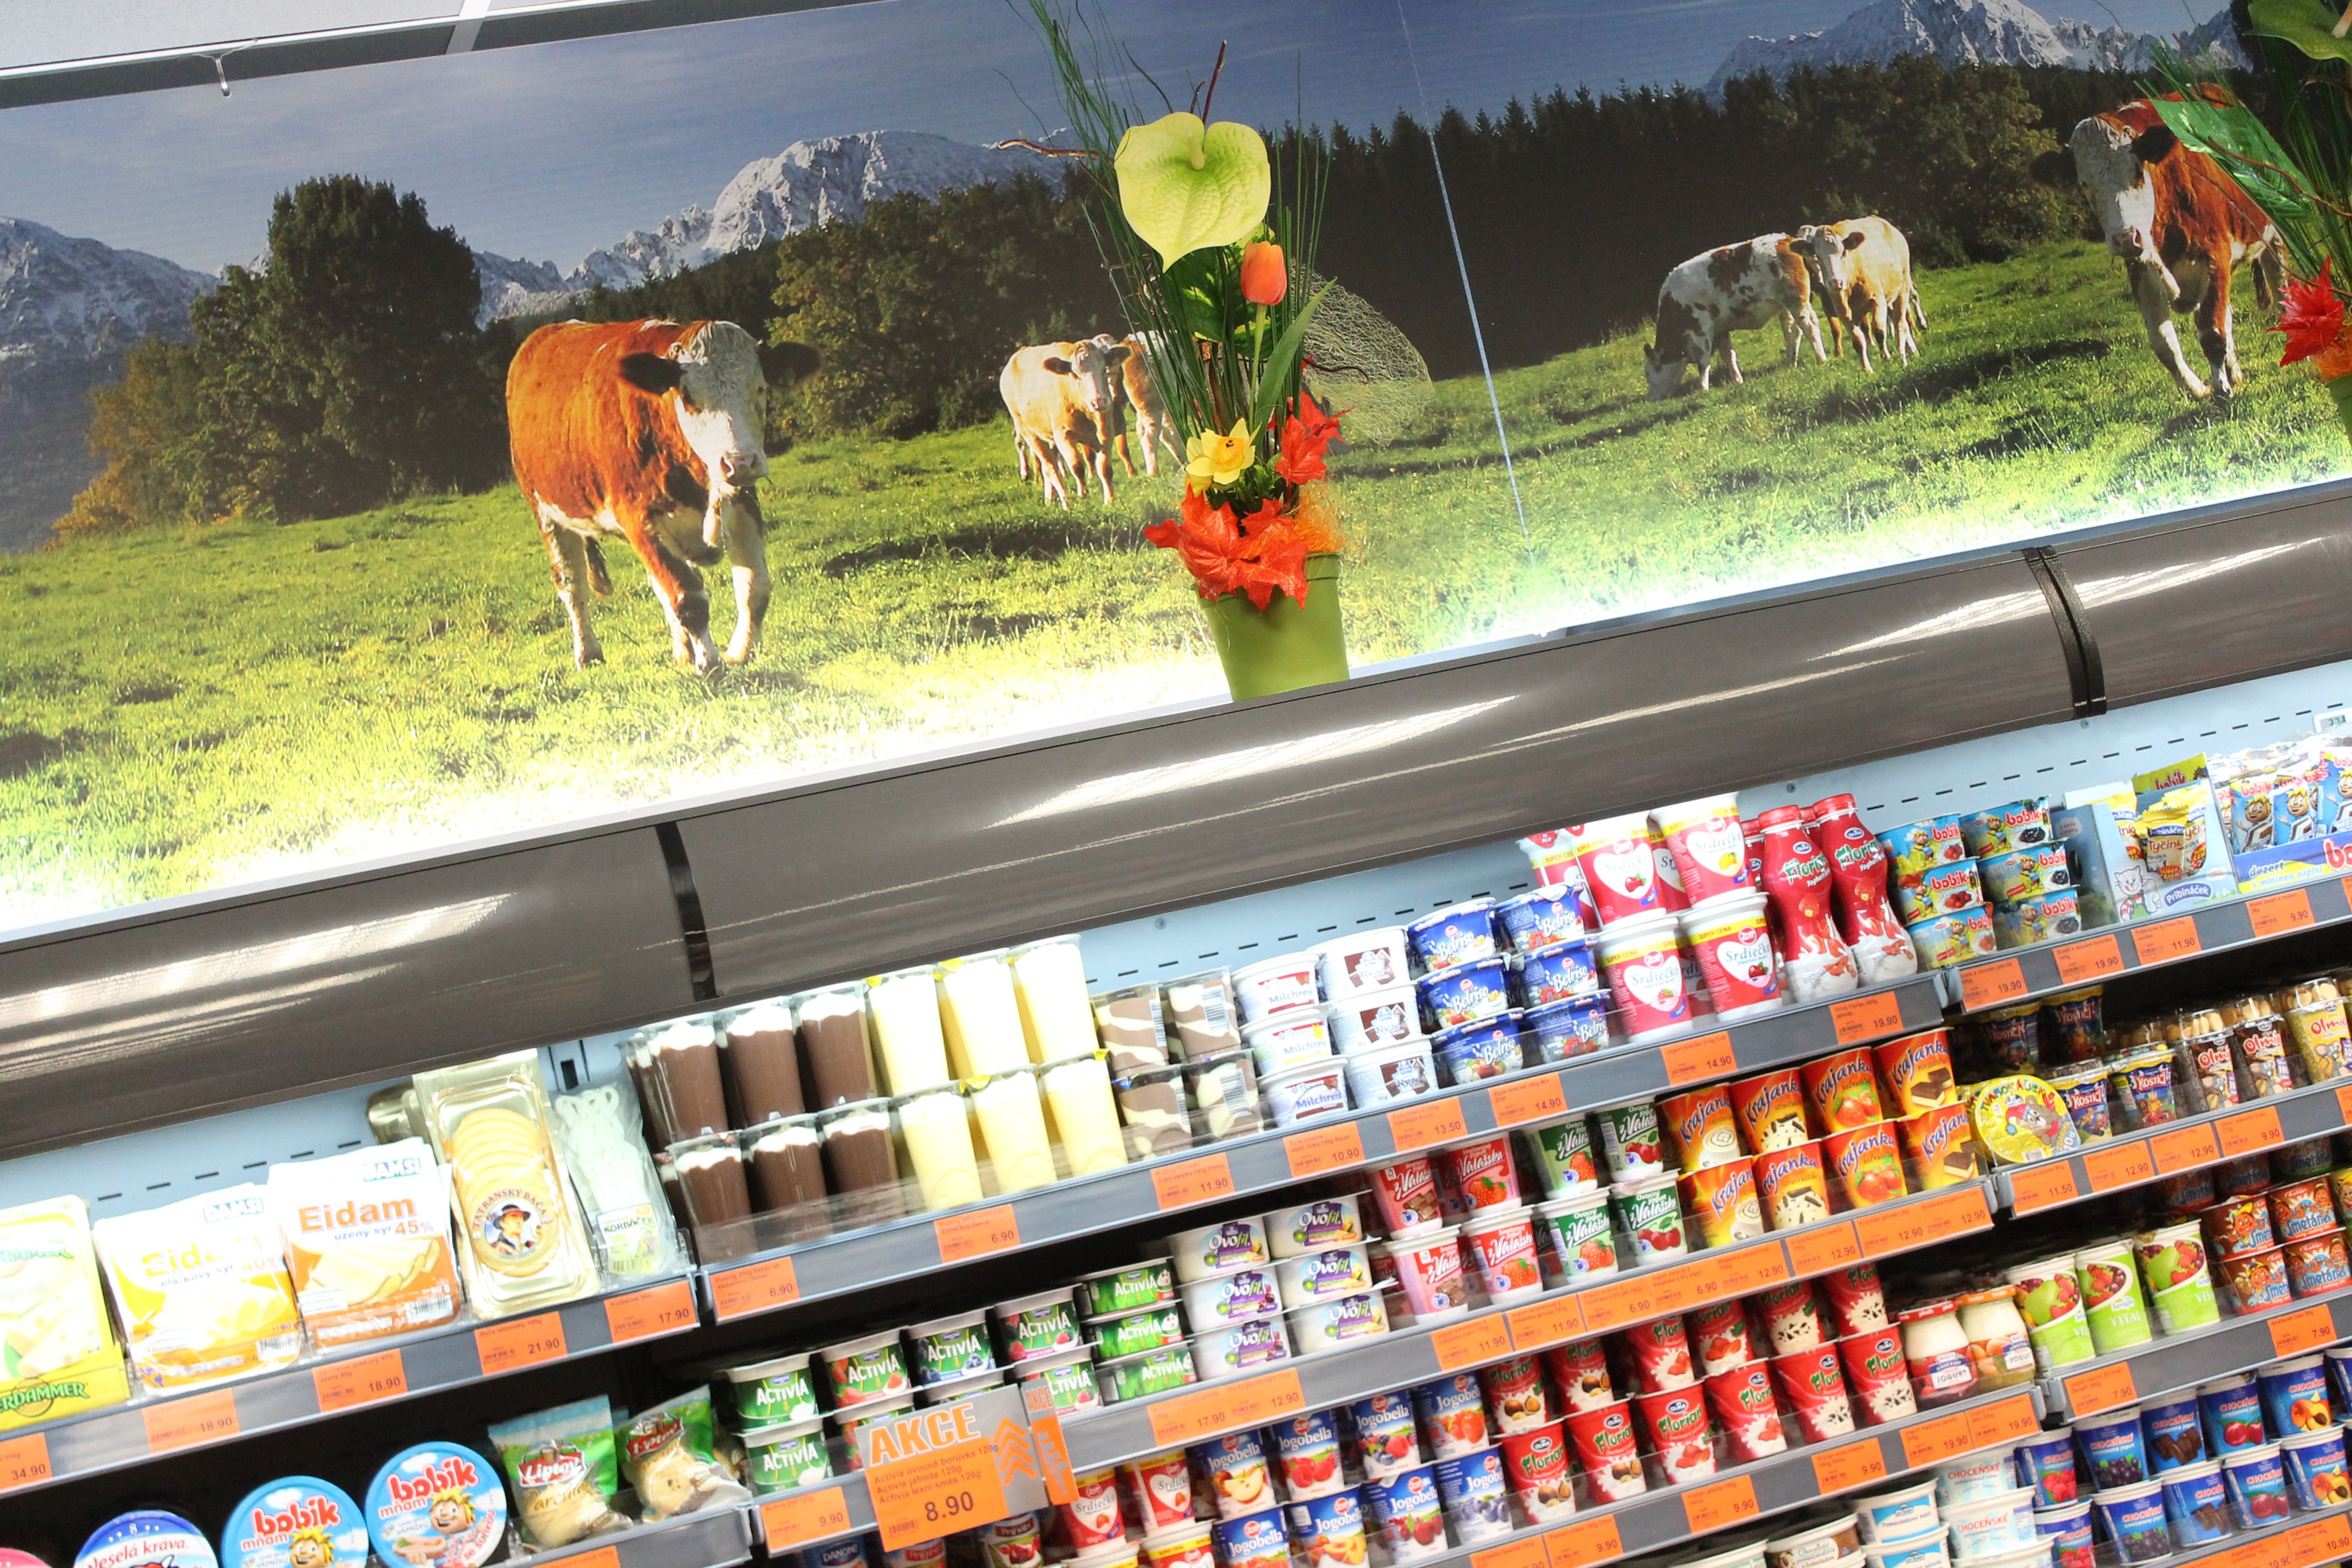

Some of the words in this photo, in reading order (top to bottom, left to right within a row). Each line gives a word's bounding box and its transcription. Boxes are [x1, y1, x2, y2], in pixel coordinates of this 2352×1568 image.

[2240, 780, 2272, 797] bobik
[2004, 808, 2042, 827] bobik
[1932, 823, 1960, 843] bobik
[2039, 850, 2067, 867] bobik
[2249, 861, 2284, 879] dezert
[2259, 873, 2294, 887] mléčnou
[2296, 865, 2323, 880] náplní
[1930, 871, 1967, 891] bobik
[2166, 884, 2209, 903] Pribináček
[2041, 897, 2075, 917] bobik
[2290, 911, 2308, 921] 9.90
[1544, 910, 1576, 938] Belriso
[1699, 931, 1716, 940] SUPER
[1717, 927, 1732, 935] CENA
[1439, 931, 1475, 961] Belriso
[1726, 942, 1770, 962] Srdiečko
[2172, 938, 2195, 951] 11.90
[2095, 957, 2118, 969] 19.90
[1554, 965, 1588, 993] Belriso
[1998, 981, 2022, 994] 19.90
[1454, 986, 1489, 1015] Belriso
[1873, 1015, 1897, 1028] 19.90
[1485, 1037, 1516, 1066] Belriso
[1706, 1056, 1732, 1069] 14.90
[1891, 1039, 1947, 1095] Krajanka
[1815, 1057, 1872, 1114] Krajanka
[2136, 1070, 2169, 1091] KOSTÍCI
[1297, 1090, 1343, 1110] Milchreis
[1535, 1098, 1561, 1111] 14.90
[2073, 1090, 2102, 1107] KOSTÍCI
[1435, 1121, 1461, 1135] 13.50
[1679, 1093, 1730, 1152] Krajank
[1921, 1106, 1968, 1165] Krajank
[2262, 1129, 2280, 1140] 9.90
[1332, 1149, 1359, 1162] 10.90
[1837, 1130, 1895, 1185] Krajanka
[2191, 1145, 2214, 1158] 12.90
[1763, 1152, 1816, 1195] rajanka
[2126, 1164, 2149, 1176] 12.90
[1200, 1178, 1228, 1192] 11.90
[2049, 1184, 2073, 1196] 11.50
[1636, 1192, 1660, 1202] Ovocný
[298, 1197, 417, 1234] Eidam
[1962, 1210, 1986, 1223] 12.90
[2286, 1211, 2333, 1236] Smetánek
[395, 1220, 435, 1235] 45%
[991, 1231, 1015, 1243] 6.90
[1899, 1228, 1923, 1241] 12.90
[1831, 1246, 1856, 1259] 12.90
[1759, 1265, 1783, 1279] 12.90
[2301, 1268, 2347, 1290] Smetánek
[769, 1283, 793, 1298] 6.90
[1115, 1274, 1158, 1297] ACTIVIA
[1697, 1282, 1716, 1295] 6.90
[658, 1308, 689, 1324] 17.90
[1629, 1301, 1650, 1313] 6.90
[1018, 1311, 1071, 1339] ACTIVIA
[1118, 1319, 1162, 1342] ACTIVIA
[1552, 1319, 1578, 1332] 11.90
[2312, 1326, 2330, 1338] 7.90
[528, 1338, 559, 1354] 21.90
[927, 1334, 981, 1362] ACTIVIA
[1479, 1336, 1505, 1350] 11.90
[848, 1354, 901, 1384] ACTIVIA
[1142, 1358, 1184, 1381] ACTIVIA
[1937, 1369, 1967, 1383] JOGURT
[369, 1377, 401, 1393] 18.90
[756, 1378, 810, 1406] ACTIVIA
[1048, 1372, 1092, 1395] CTIVIA
[2113, 1387, 2132, 1399] 7.90
[1026, 1387, 1052, 1413] AKCE
[1271, 1392, 1298, 1406] 12.90
[1437, 1384, 1480, 1410] Jogobell
[201, 1417, 233, 1433] 18.90
[1197, 1412, 1225, 1427] 17.90
[1356, 1405, 1409, 1429] Jogobella
[1658, 1403, 1703, 1440] Florian
[2009, 1417, 2033, 1430] 19.90
[870, 1403, 981, 1462] AKCE
[1279, 1427, 1332, 1450] Jogobella
[1943, 1436, 1968, 1450] 19.90
[763, 1443, 818, 1472] ACTIVIA
[874, 1471, 904, 1485] Activia
[906, 1460, 938, 1475] ovocná
[941, 1451, 975, 1466] borůvka
[978, 1444, 998, 1456] 120g
[1207, 1442, 1261, 1471] Jogobella
[1522, 1443, 1563, 1477] Florian
[12, 1464, 46, 1481] 34.90
[386, 1456, 479, 1501] bobik
[1862, 1462, 1882, 1476] 9.90
[1947, 1463, 2000, 1479] CHOCEŇSKÉ
[877, 1480, 907, 1494] Activia
[909, 1472, 939, 1487] jahoda
[941, 1465, 963, 1478] 120g
[880, 1490, 910, 1505] Activia
[961, 1470, 982, 1483] 120g
[379, 1497, 427, 1519] mňam
[925, 1491, 974, 1522] 8.90
[1389, 1485, 1439, 1513] Jogobell
[1733, 1499, 1754, 1513] 9.90
[251, 1495, 342, 1536] bobik
[819, 1512, 843, 1526] 9.90
[1957, 1513, 2009, 1532] CHOCEŇSKÉ
[128, 1523, 137, 1534] 8
[241, 1531, 289, 1552] mňam
[1230, 1530, 1283, 1556] Jogobella
[1596, 1539, 1617, 1552] 9.90
[2327, 1537, 2350, 1550] 10.90
